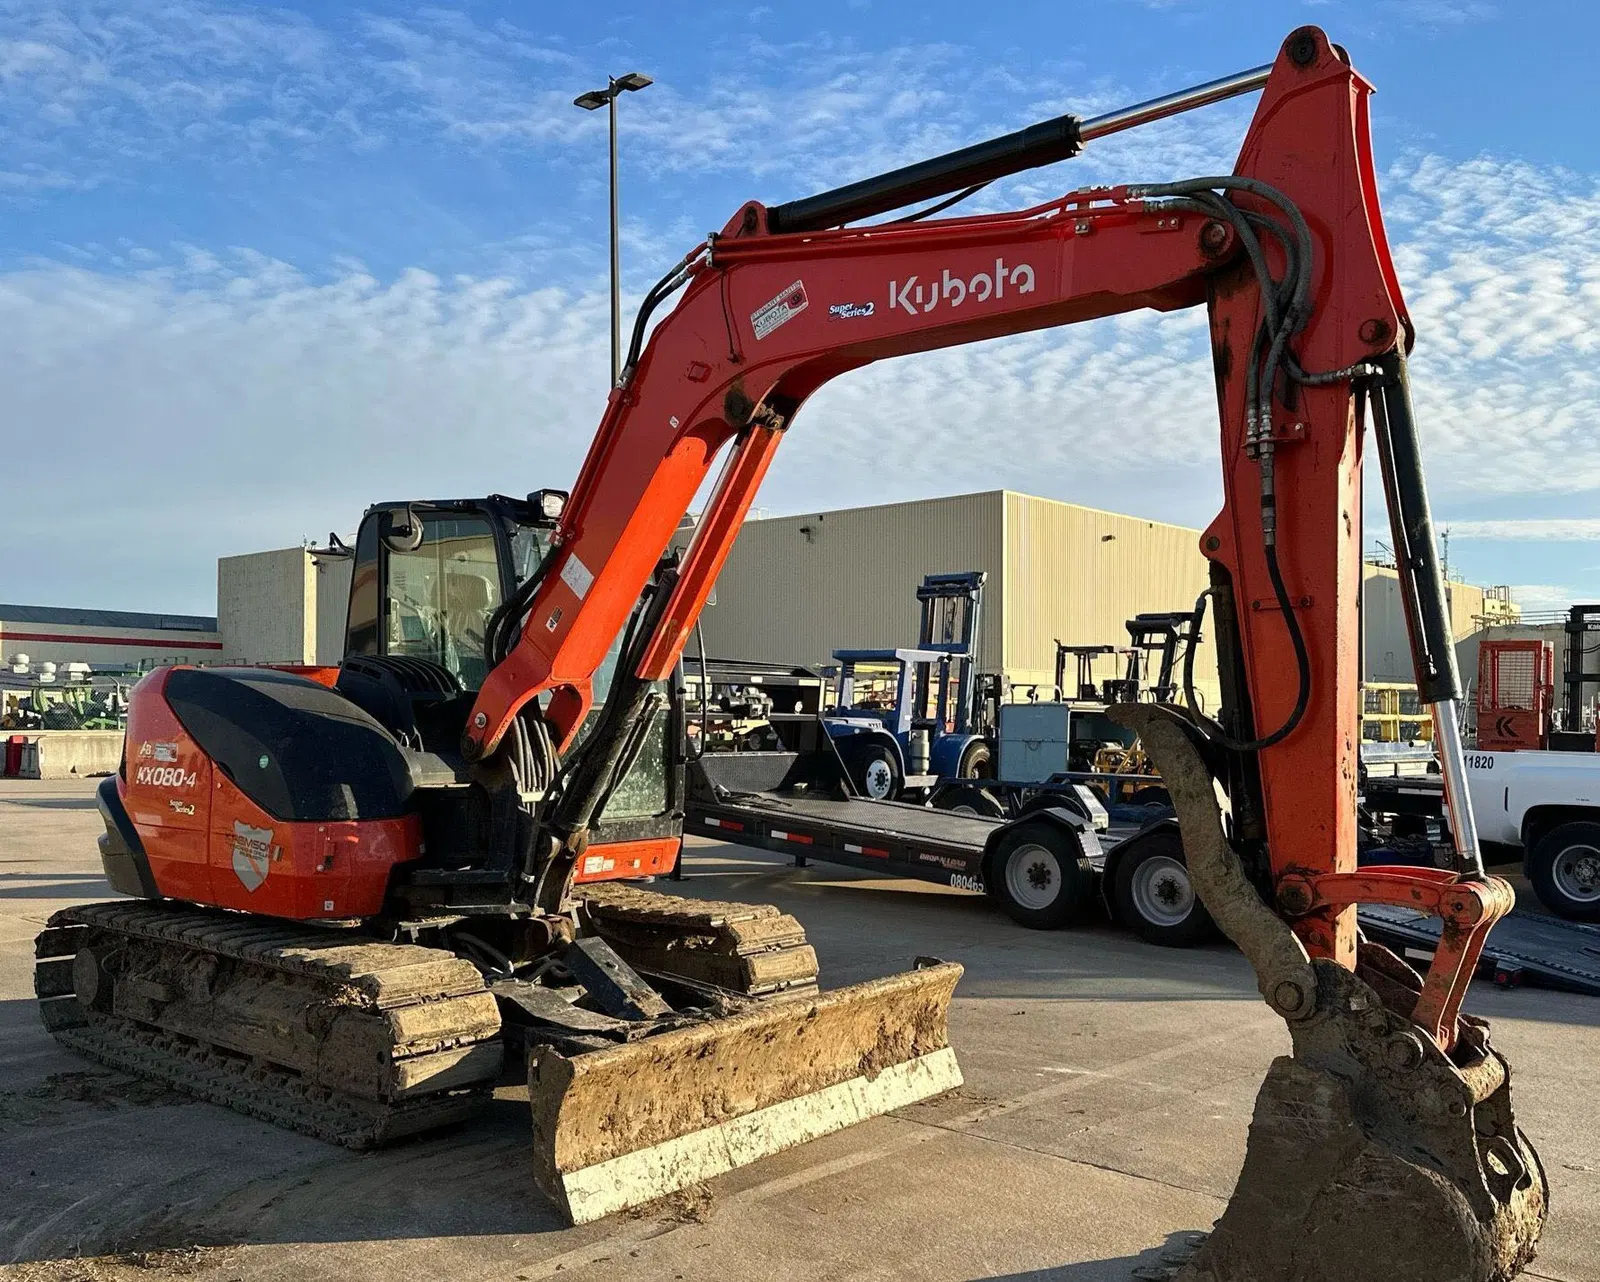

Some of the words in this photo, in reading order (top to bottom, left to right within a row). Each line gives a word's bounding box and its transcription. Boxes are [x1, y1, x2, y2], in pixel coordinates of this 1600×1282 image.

[889, 257, 1035, 316] Kubota
[754, 304, 789, 331] KUBOTA
[829, 303, 854, 315] Super
